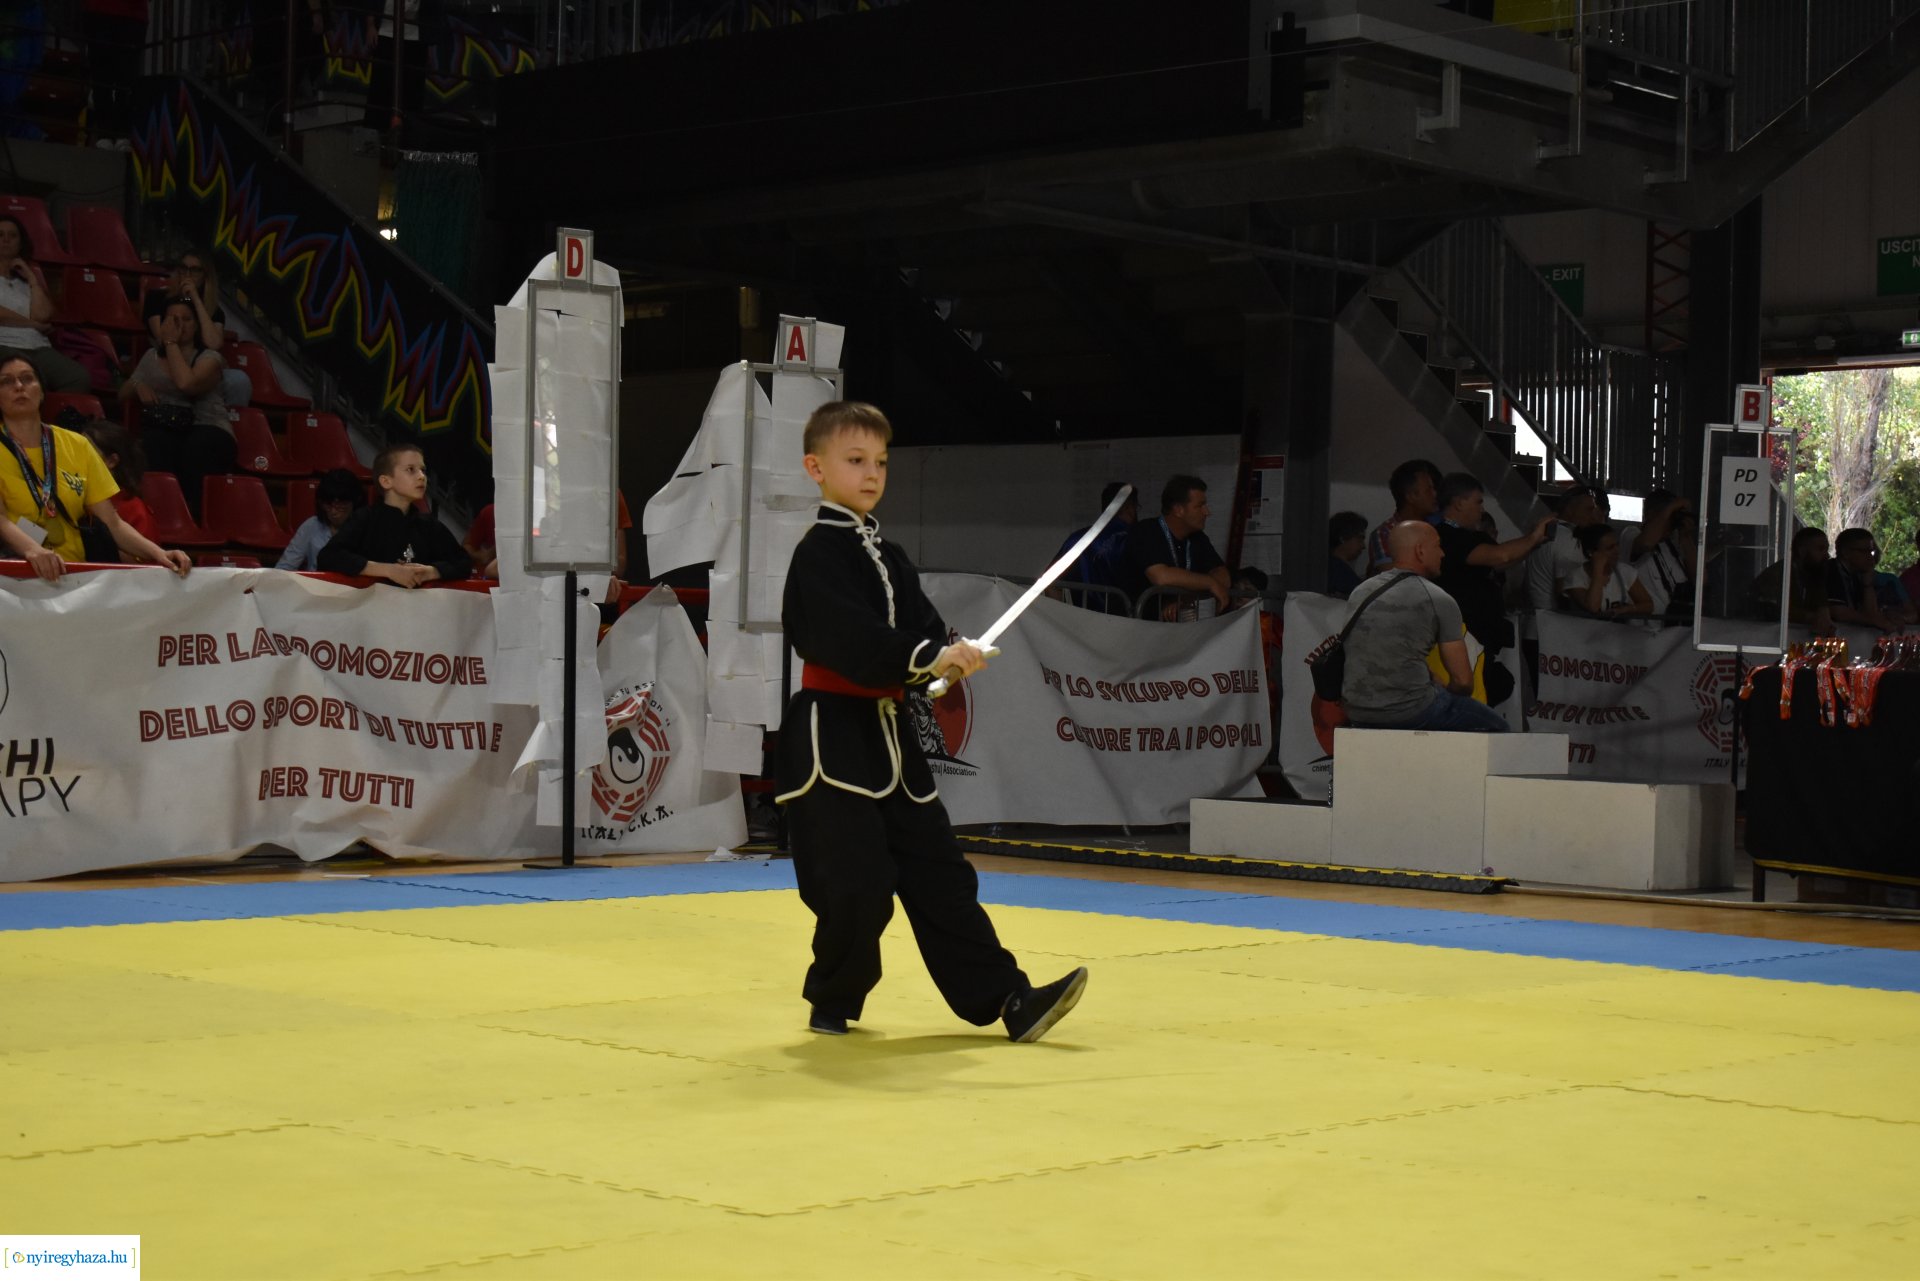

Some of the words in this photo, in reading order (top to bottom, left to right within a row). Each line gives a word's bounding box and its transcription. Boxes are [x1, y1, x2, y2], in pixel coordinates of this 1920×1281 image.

[566, 237, 584, 278] D
[1552, 267, 1581, 281] EXIT
[786, 325, 807, 361] A
[1743, 391, 1760, 421] B
[1733, 468, 1758, 483] PD
[1734, 492, 1756, 507] 07
[158, 634, 219, 667] PER
[227, 627, 278, 663] LA
[1066, 674, 1094, 698] LO
[1096, 677, 1211, 703] SVILUPPO
[1212, 669, 1260, 695] DELLE
[140, 699, 256, 742] DELLO
[263, 695, 360, 731] SPORT
[362, 711, 397, 742] DI
[398, 717, 487, 751] TUTTI
[491, 722, 503, 753] E
[1137, 727, 1181, 752] TRA
[1185, 726, 1193, 750] I
[1196, 723, 1262, 749] POPOLI
[0, 737, 54, 777] HI
[258, 765, 308, 800] PER
[318, 766, 415, 809] TUTTI
